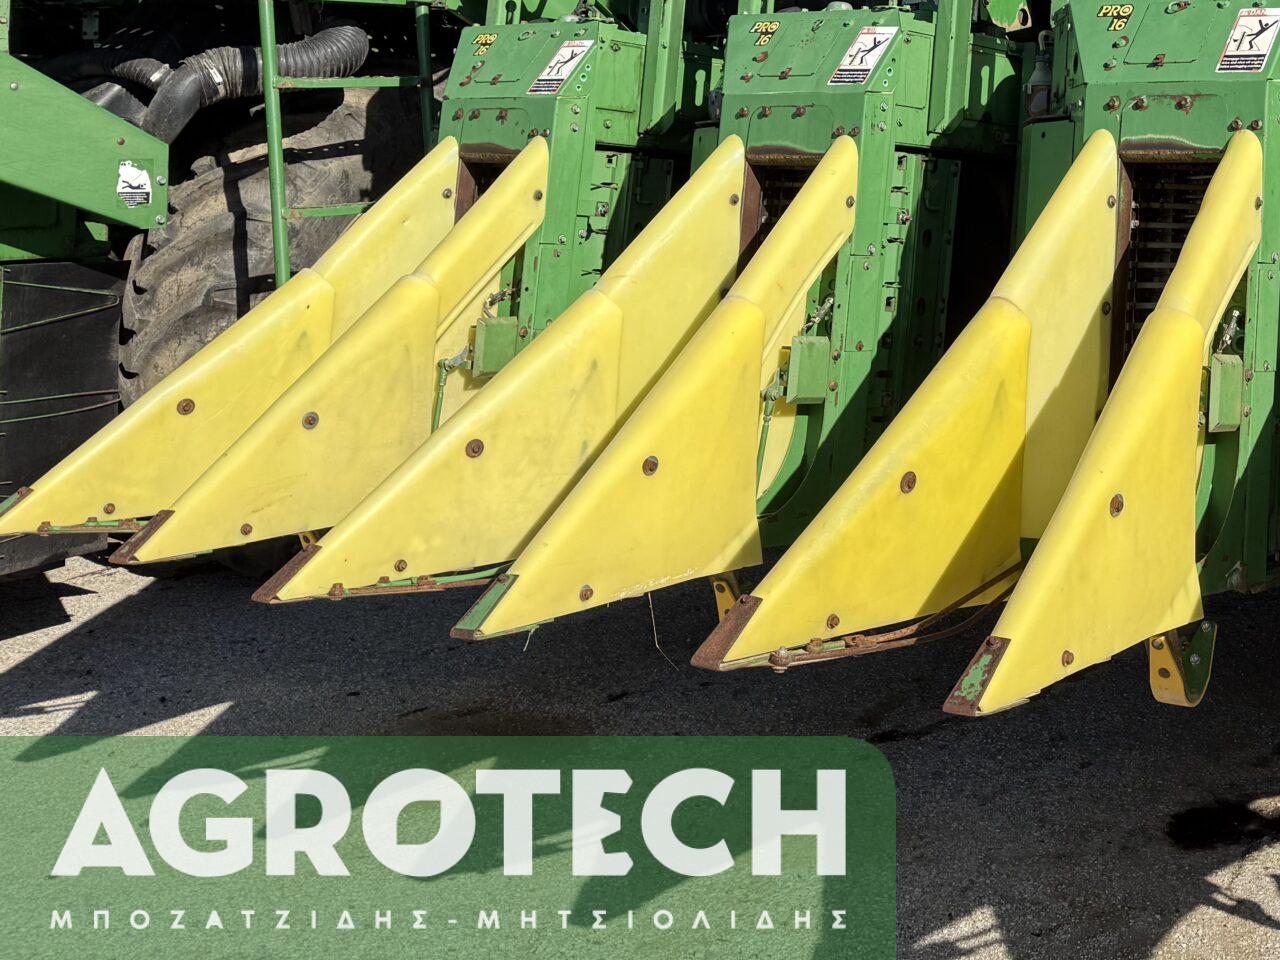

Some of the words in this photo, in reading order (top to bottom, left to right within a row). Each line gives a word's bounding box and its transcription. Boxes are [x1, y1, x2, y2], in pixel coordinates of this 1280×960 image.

[1097, 4, 1134, 16] PRO
[749, 21, 780, 33] PRO
[1108, 18, 1128, 31] 16
[472, 34, 498, 44] PRO
[754, 34, 772, 46] 16
[474, 45, 489, 56] 16
